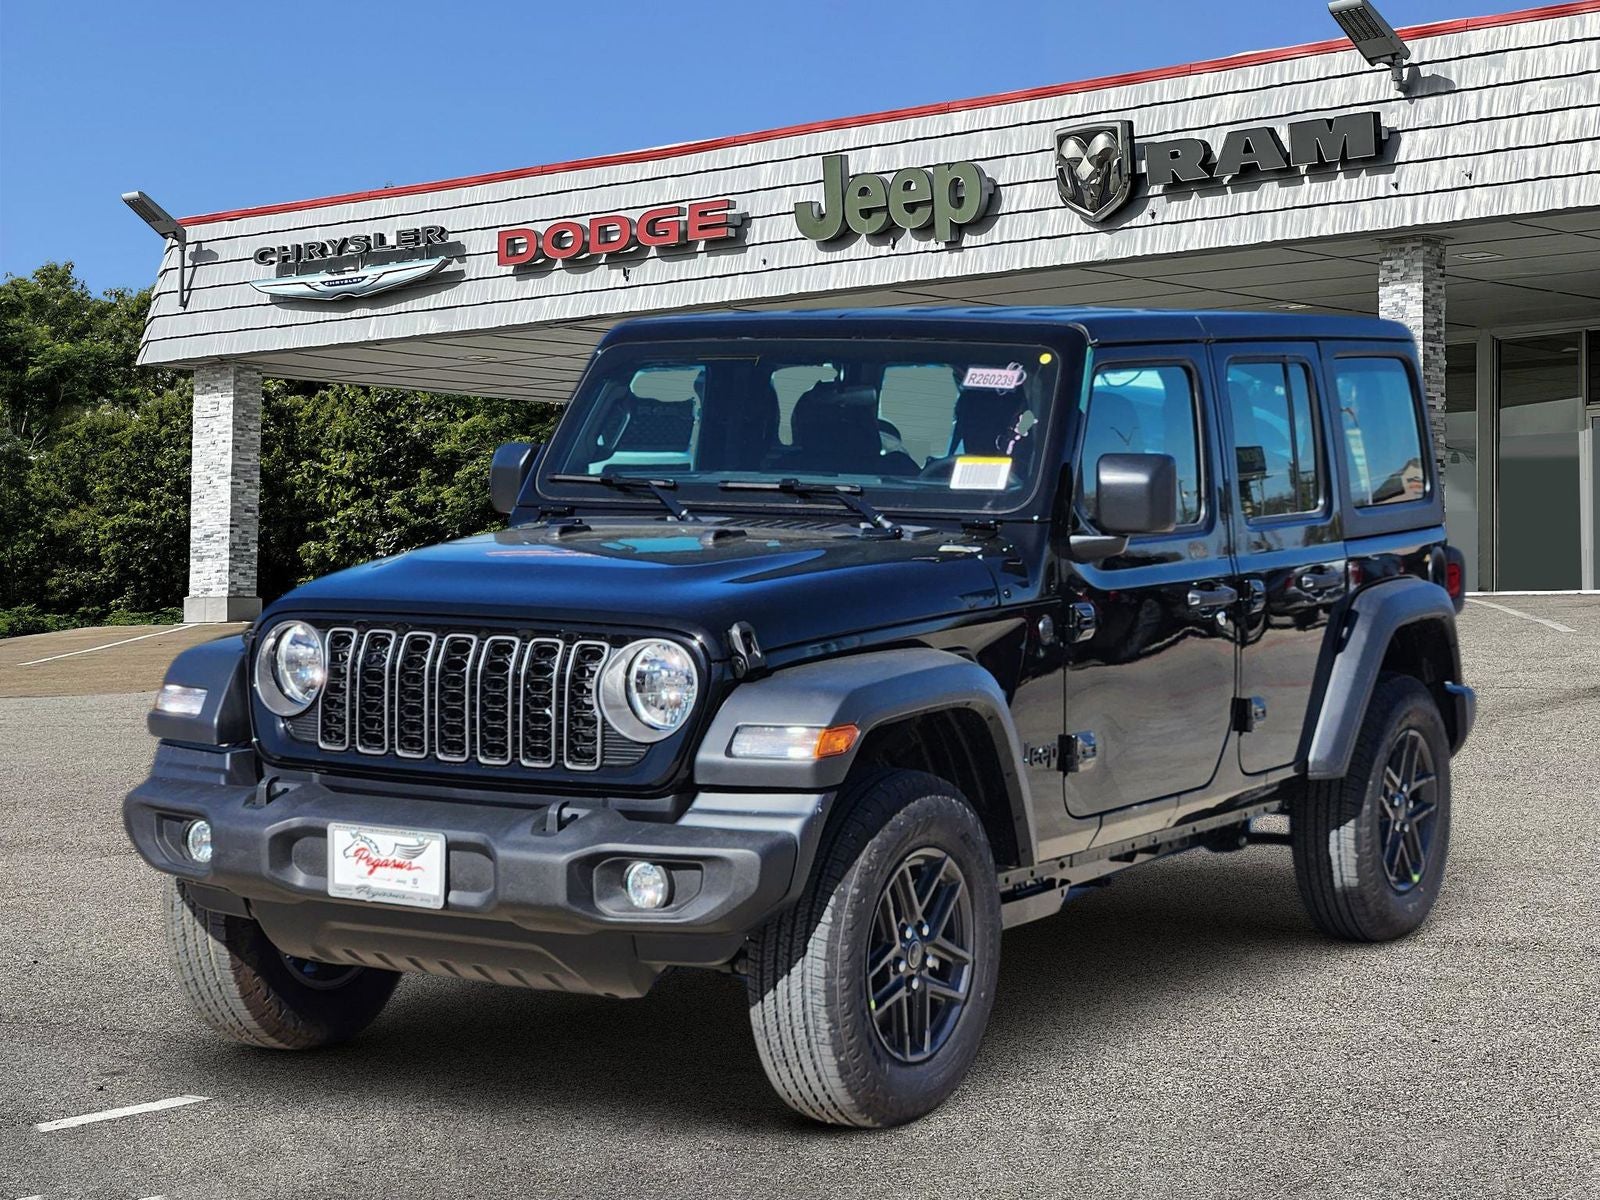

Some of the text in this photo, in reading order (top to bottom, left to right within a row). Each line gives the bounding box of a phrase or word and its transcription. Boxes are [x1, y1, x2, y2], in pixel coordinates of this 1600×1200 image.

[1144, 112, 1382, 186] RAM
[794, 154, 989, 243] Jeep
[253, 225, 449, 266] CHRYSLER
[497, 199, 736, 267] DODGE
[324, 277, 363, 286] CHRYSLER
[967, 373, 1015, 387] R260239
[353, 847, 424, 875] Pegasus
